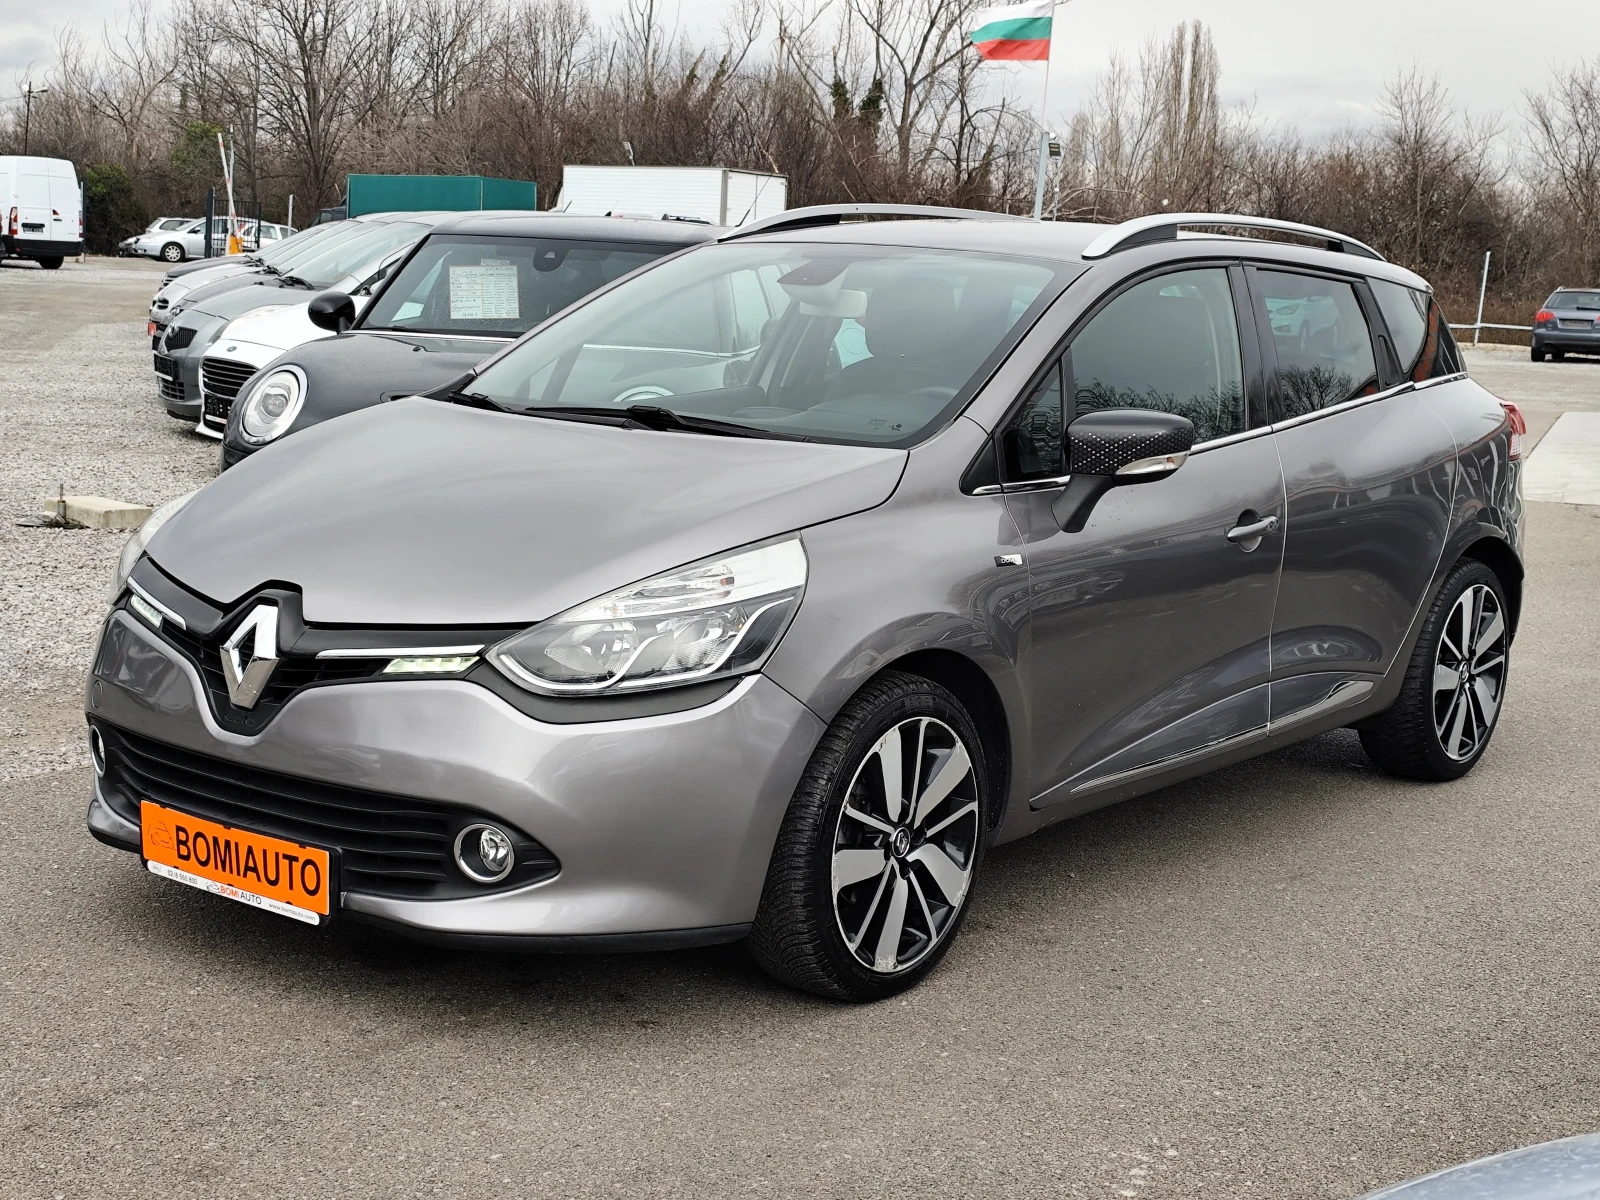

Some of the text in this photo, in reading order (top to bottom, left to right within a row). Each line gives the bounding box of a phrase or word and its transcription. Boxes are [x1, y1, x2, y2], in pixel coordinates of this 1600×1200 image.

[175, 824, 321, 897] BOMIAUTO
[220, 885, 262, 905] BOMI AUTO
